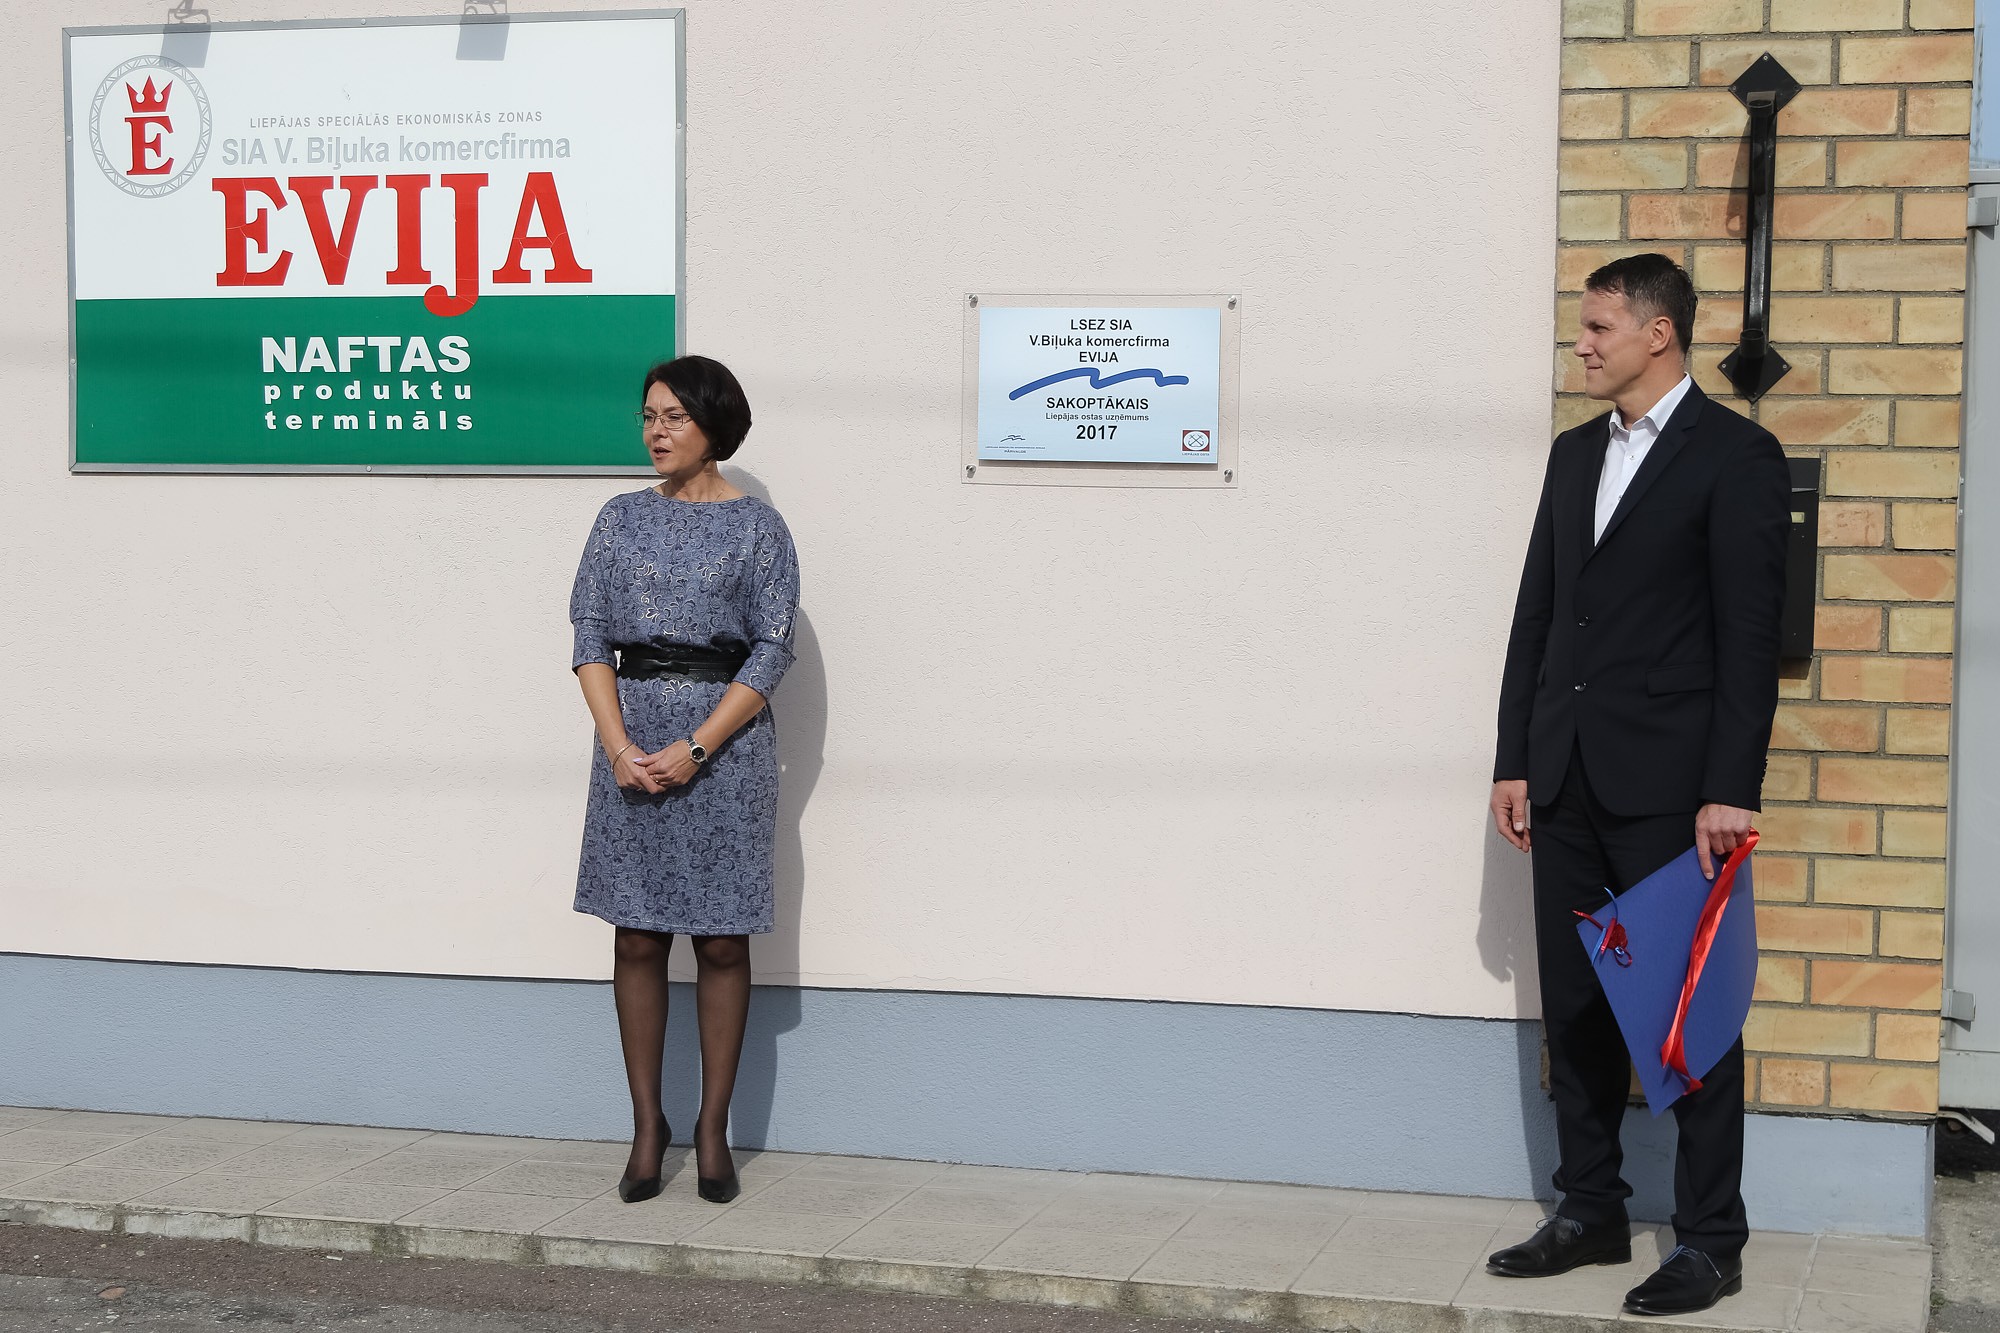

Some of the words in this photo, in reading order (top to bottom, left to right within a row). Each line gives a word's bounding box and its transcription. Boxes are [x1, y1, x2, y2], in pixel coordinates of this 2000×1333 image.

[250, 115, 311, 128] LIEPĀJAS
[318, 113, 389, 127] SPECIĀLĀS
[396, 111, 492, 125] EKONOMISKĀS
[498, 111, 542, 123] ZONAS
[125, 116, 174, 175] E
[222, 138, 268, 165] SIA
[274, 137, 298, 164] V.
[307, 136, 390, 170] Biļuka
[399, 132, 571, 162] komercfirma
[211, 172, 593, 317] EVIJA
[1070, 319, 1106, 330] LSEZ
[1109, 319, 1133, 330] SIA
[1029, 335, 1082, 349] V.Biļuka
[1086, 335, 1170, 347] komercfirma
[262, 335, 471, 373] NAFTAS
[1079, 351, 1119, 363] EVIJA
[264, 380, 471, 405] produktu
[1046, 396, 1149, 410] SAKOPTĀKAIS
[264, 410, 473, 430] termināls
[1046, 412, 1079, 421] Liepājas
[1081, 413, 1103, 421] ostas
[1105, 414, 1149, 422] uzņēmums
[1076, 425, 1118, 440] 2017
